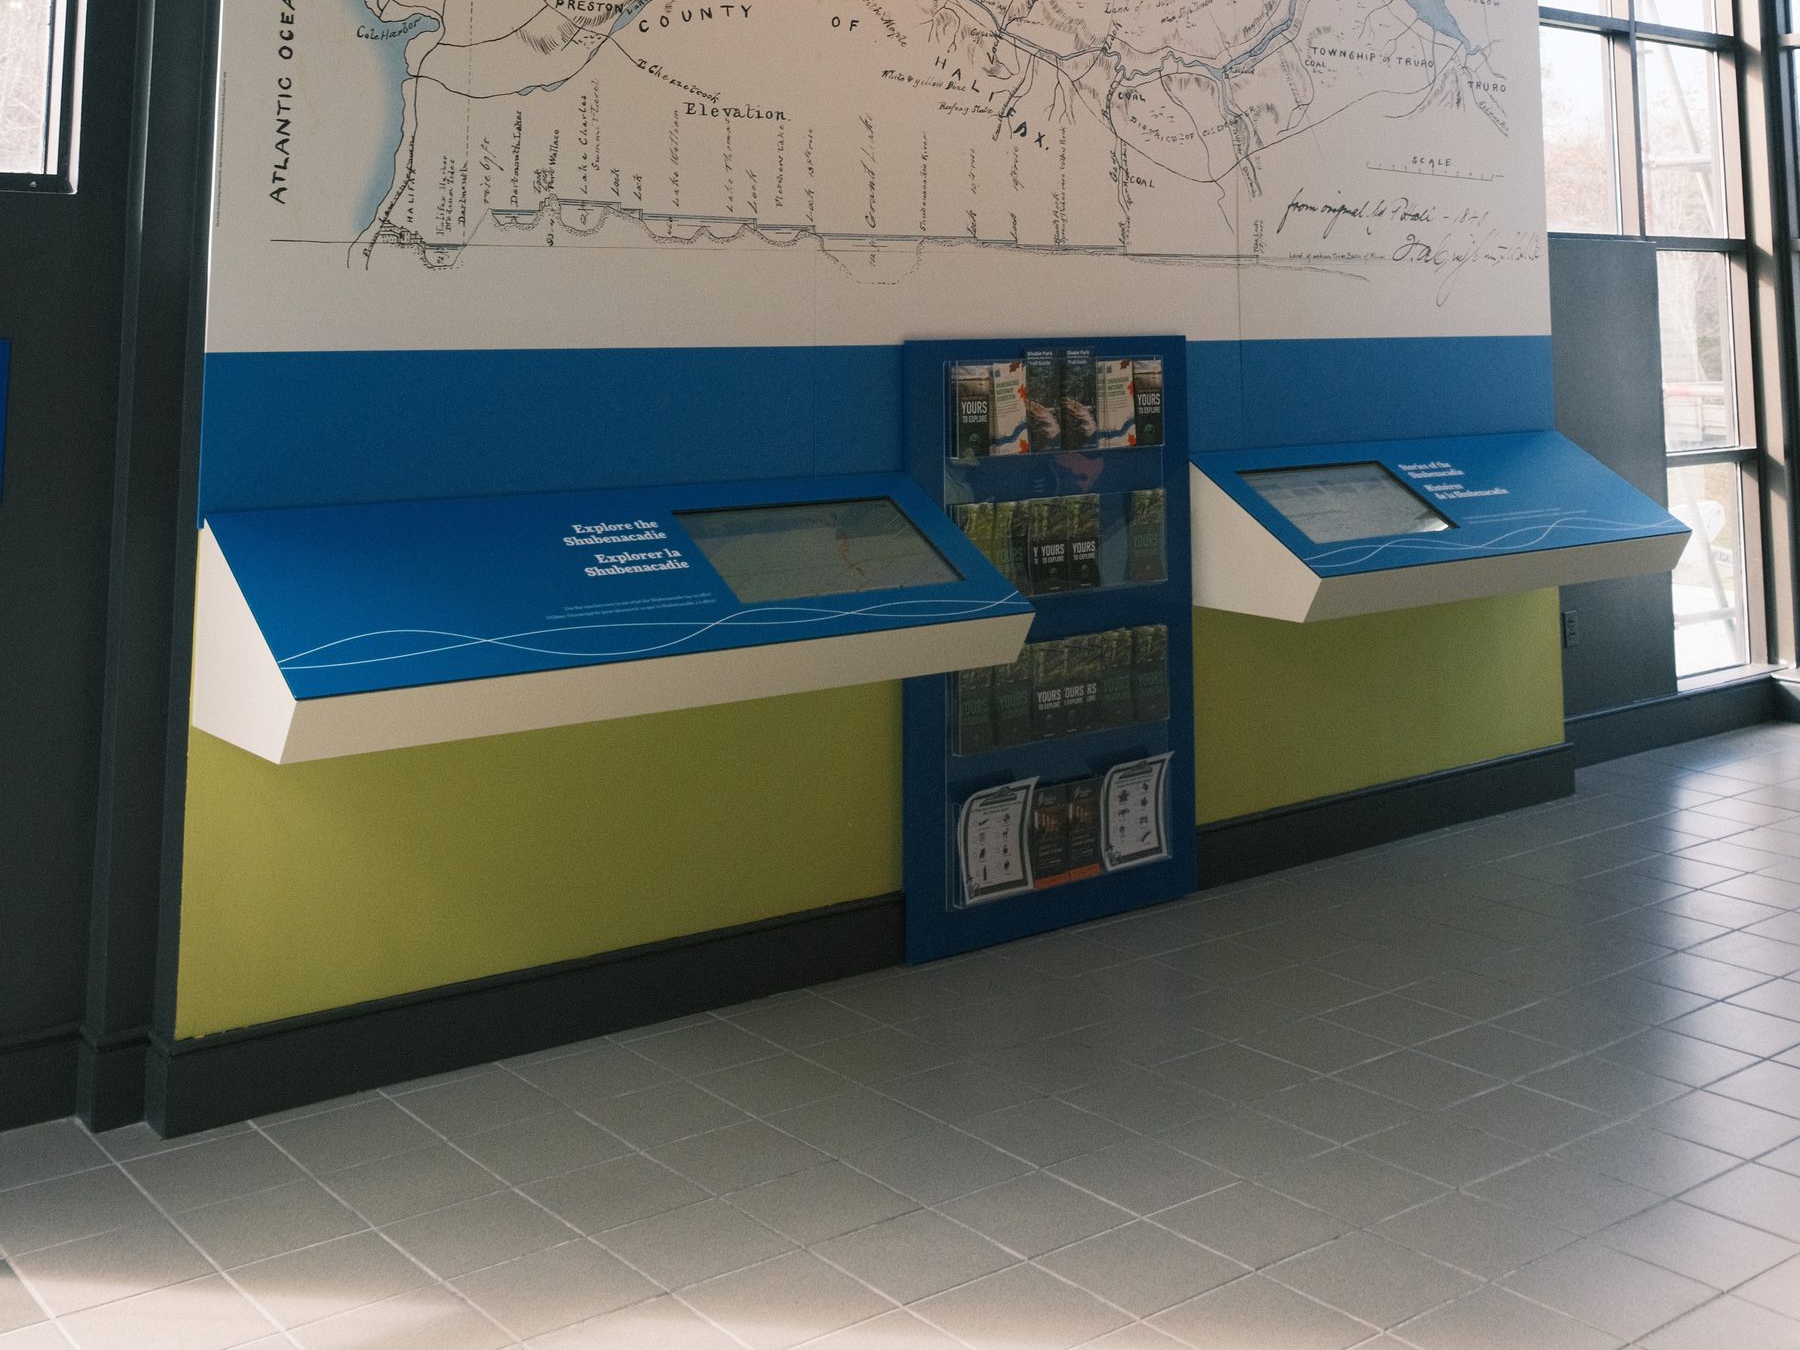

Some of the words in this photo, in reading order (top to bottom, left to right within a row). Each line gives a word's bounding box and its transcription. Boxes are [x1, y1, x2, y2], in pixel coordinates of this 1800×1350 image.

[380, 18, 422, 40] Harbor
[639, 4, 752, 33] COUNTY
[831, 16, 860, 32] OF
[1305, 59, 1327, 68] COAL
[1311, 46, 1376, 62] TOWNSHIP
[1396, 57, 1433, 68] TRURO
[1468, 80, 1507, 93] TRURO
[577, 95, 588, 145] Charles
[684, 101, 792, 122] Elevation.
[270, 76, 292, 204] ATLANTIC
[549, 130, 559, 165] Wallace
[669, 109, 680, 165] William
[723, 118, 733, 171] Thomas
[776, 124, 784, 151] Lake
[1412, 156, 1452, 167] SCALE
[579, 153, 588, 194] Lake
[611, 168, 620, 196] Lock
[1130, 175, 1155, 188] COAL
[407, 167, 416, 223] HALIFAX
[669, 171, 680, 207] Lake
[859, 160, 877, 228] Grand
[1276, 187, 1318, 235] from
[961, 401, 988, 415] YOURS
[1137, 393, 1161, 406] YOURS
[563, 530, 667, 547] Shubenacadie
[571, 522, 633, 535] Explore
[633, 520, 660, 530] the
[594, 551, 663, 564] Explorer
[663, 549, 682, 557] la
[1041, 544, 1065, 556] YOURS
[1072, 541, 1096, 554] YOURS
[584, 559, 690, 577] Shubenacadie
[1037, 690, 1061, 703] YOURS
